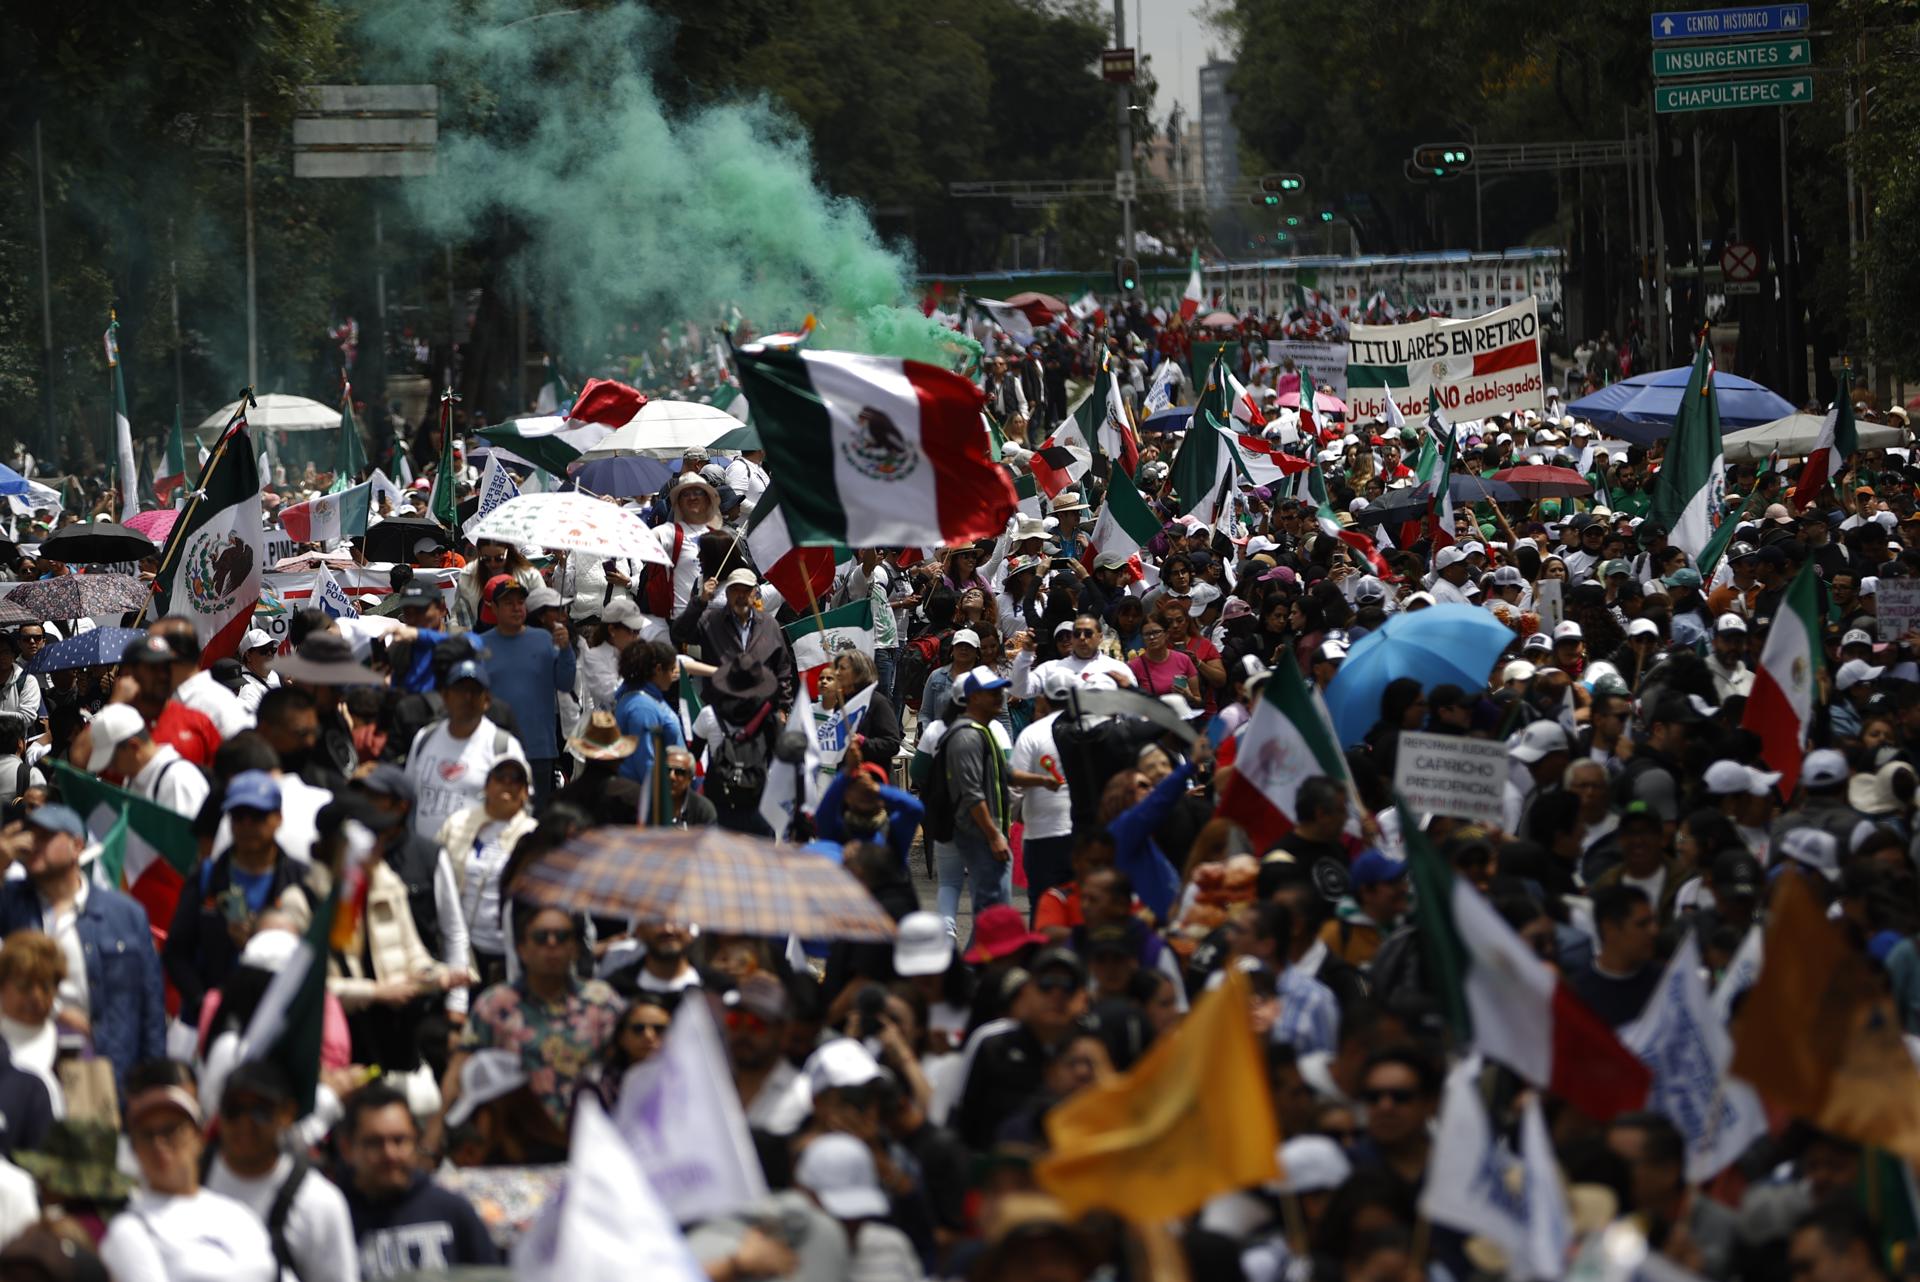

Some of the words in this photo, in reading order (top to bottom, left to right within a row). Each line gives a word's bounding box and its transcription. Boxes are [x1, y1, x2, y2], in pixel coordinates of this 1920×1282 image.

[1686, 15, 1720, 33] CENTRO
[1723, 11, 1769, 29] HISTORICO
[1666, 47, 1778, 70] INSURGENTES
[1668, 84, 1781, 107] CHAPULTEPEC
[1350, 332, 1449, 364] TITULARES
[1452, 329, 1473, 355] EN
[1476, 312, 1536, 351] RETIRO
[1346, 395, 1431, 423] jubidos
[1434, 385, 1460, 409] NO
[1464, 372, 1542, 405] doblegados
